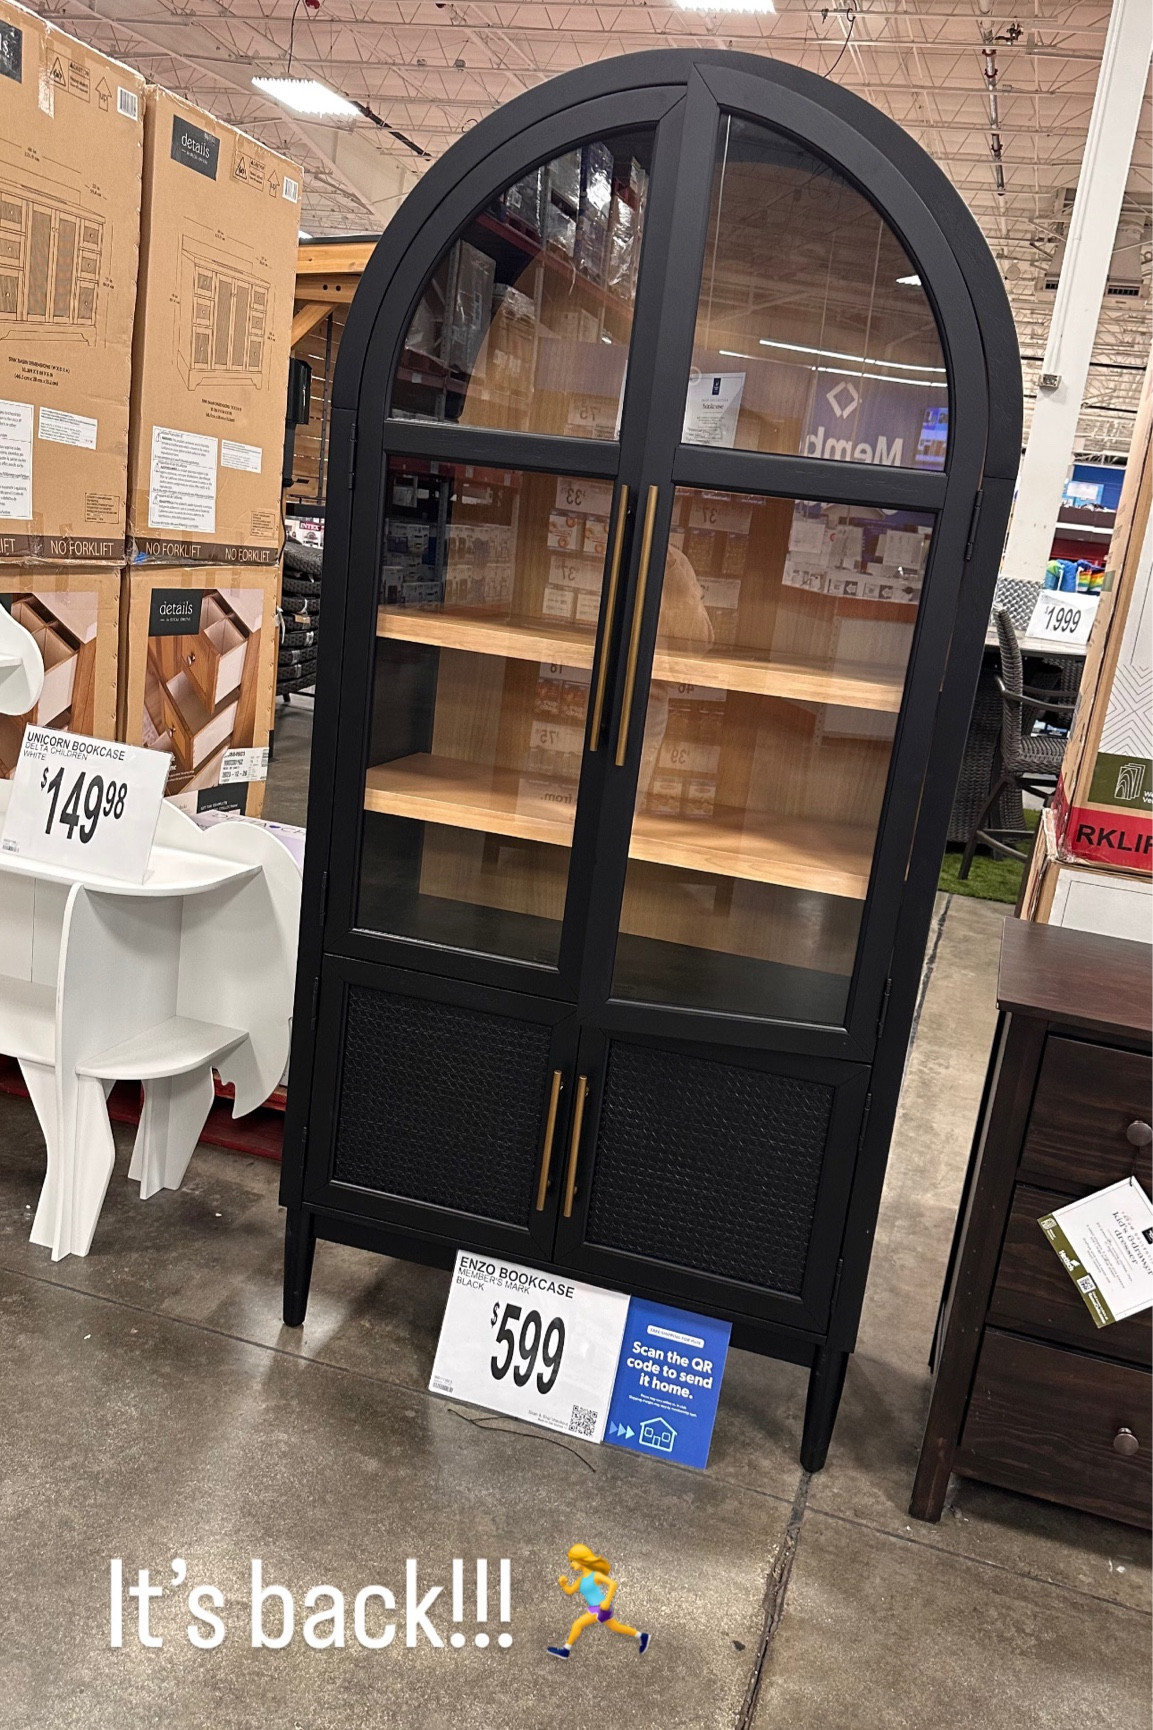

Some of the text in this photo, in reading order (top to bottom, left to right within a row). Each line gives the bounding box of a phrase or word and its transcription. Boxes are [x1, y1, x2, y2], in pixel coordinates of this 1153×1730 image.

[181, 133, 210, 159] details
[51, 540, 114, 557] NO FORKLIFT
[146, 542, 202, 558] NO FORKLIFT
[225, 548, 270, 563] NO FORKLIFT
[160, 600, 193, 615] details
[23, 750, 47, 761] WHITE
[25, 741, 88, 760] DELTA CHILDREN
[27, 731, 126, 761] UNICORN BOOKCASE
[1114, 1229, 1138, 1265] dresser
[456, 1276, 484, 1291] BLACK
[458, 1267, 531, 1295] MEMBER'S MARK
[460, 1256, 575, 1299] ENZO BOOKCASE
[491, 1301, 566, 1395] $599
[632, 1341, 713, 1374] Scan the QR
[627, 1357, 713, 1389] code to send
[639, 1372, 694, 1399] it home.
